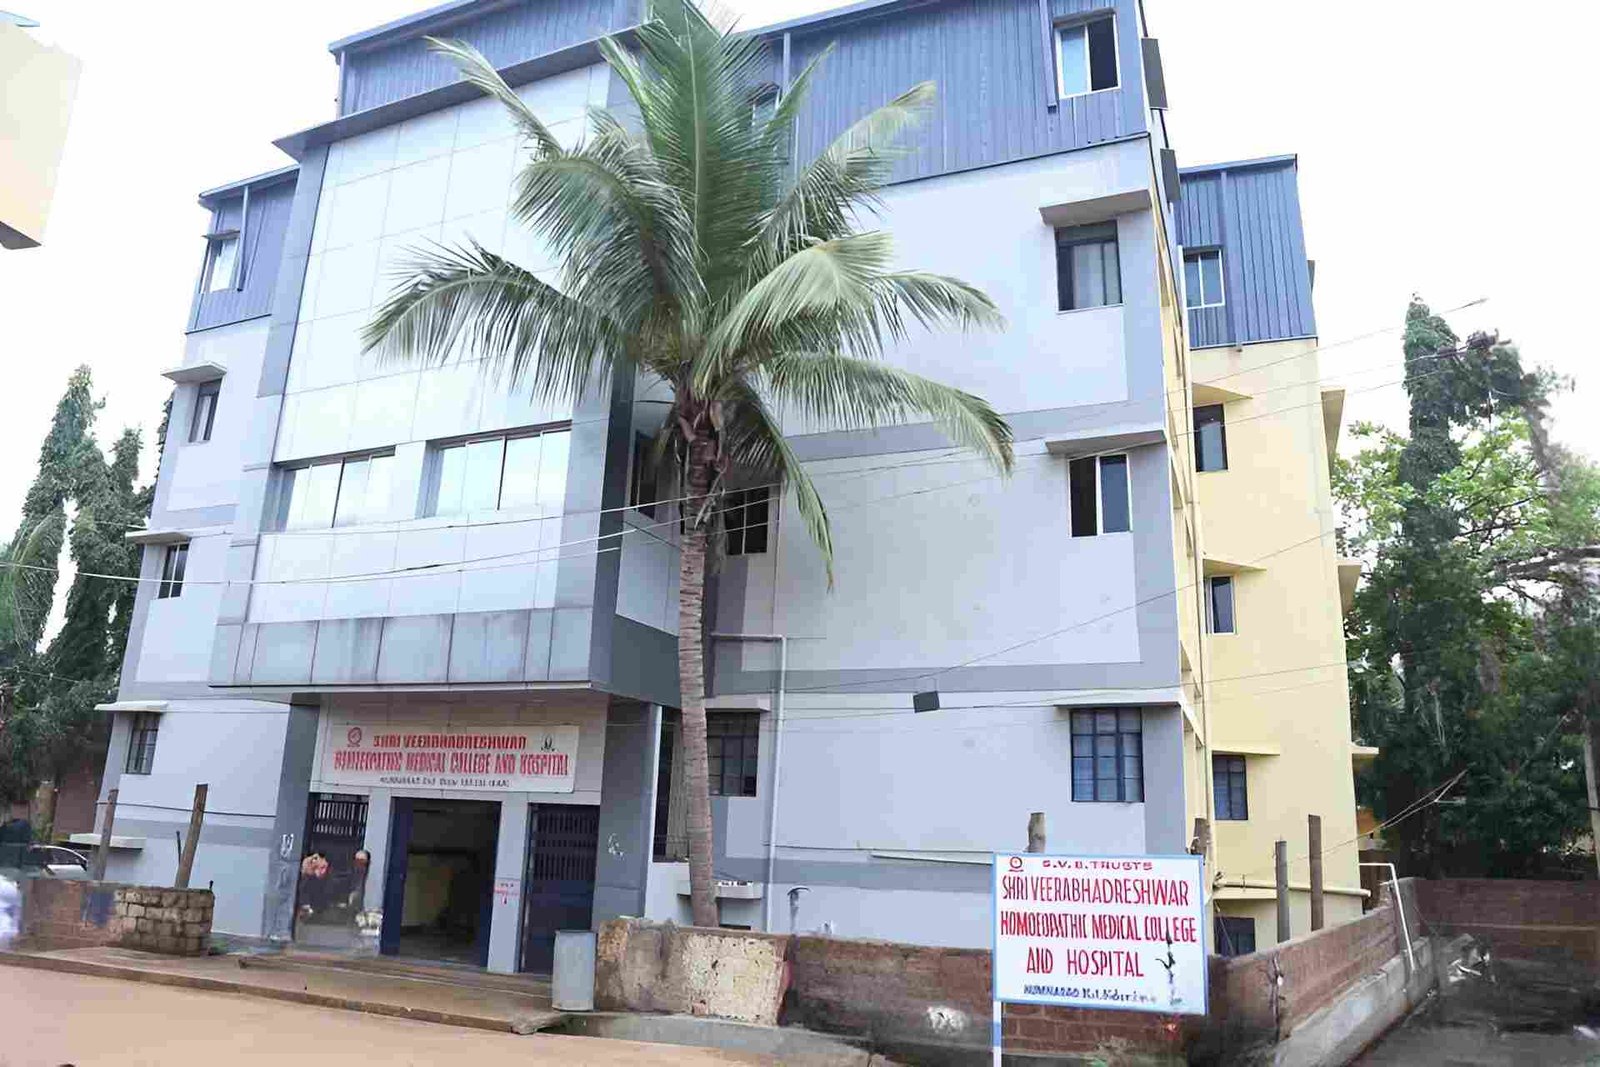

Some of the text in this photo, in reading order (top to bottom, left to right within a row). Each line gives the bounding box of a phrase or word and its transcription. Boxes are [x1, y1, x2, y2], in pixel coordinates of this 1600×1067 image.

[1002, 875, 1189, 906] SHRI VEERABHADRESHWAR
[1091, 914, 1142, 941] MEDICAL
[1145, 916, 1197, 943] COLLEGE
[1026, 946, 1145, 977] AND HOSPITAL
